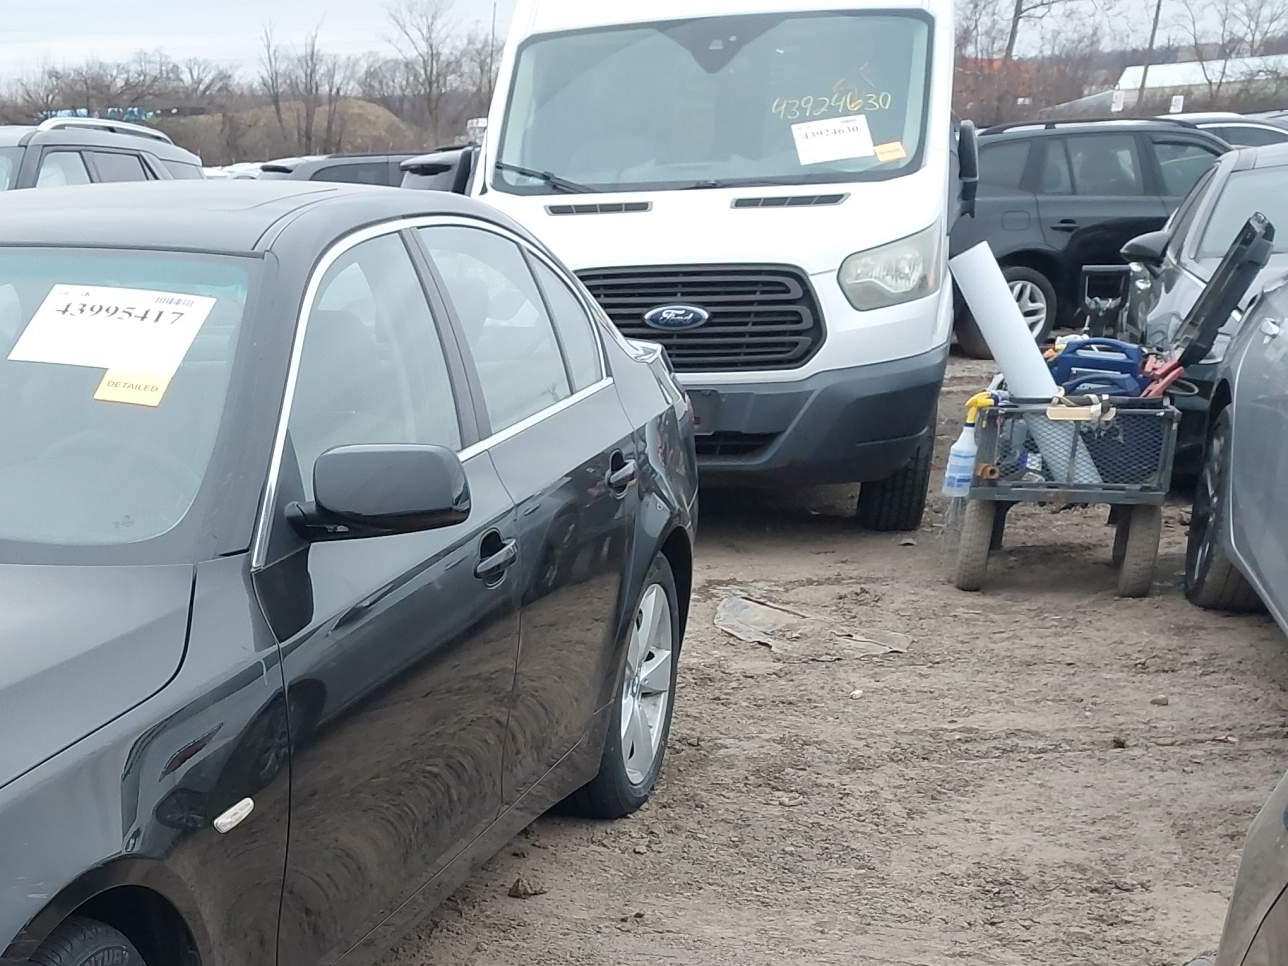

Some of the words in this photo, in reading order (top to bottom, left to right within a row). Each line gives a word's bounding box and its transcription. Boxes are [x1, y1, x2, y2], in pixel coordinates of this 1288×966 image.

[771, 91, 892, 119] 43924630
[55, 301, 185, 325] 43995417
[106, 379, 160, 393] DETAILED
